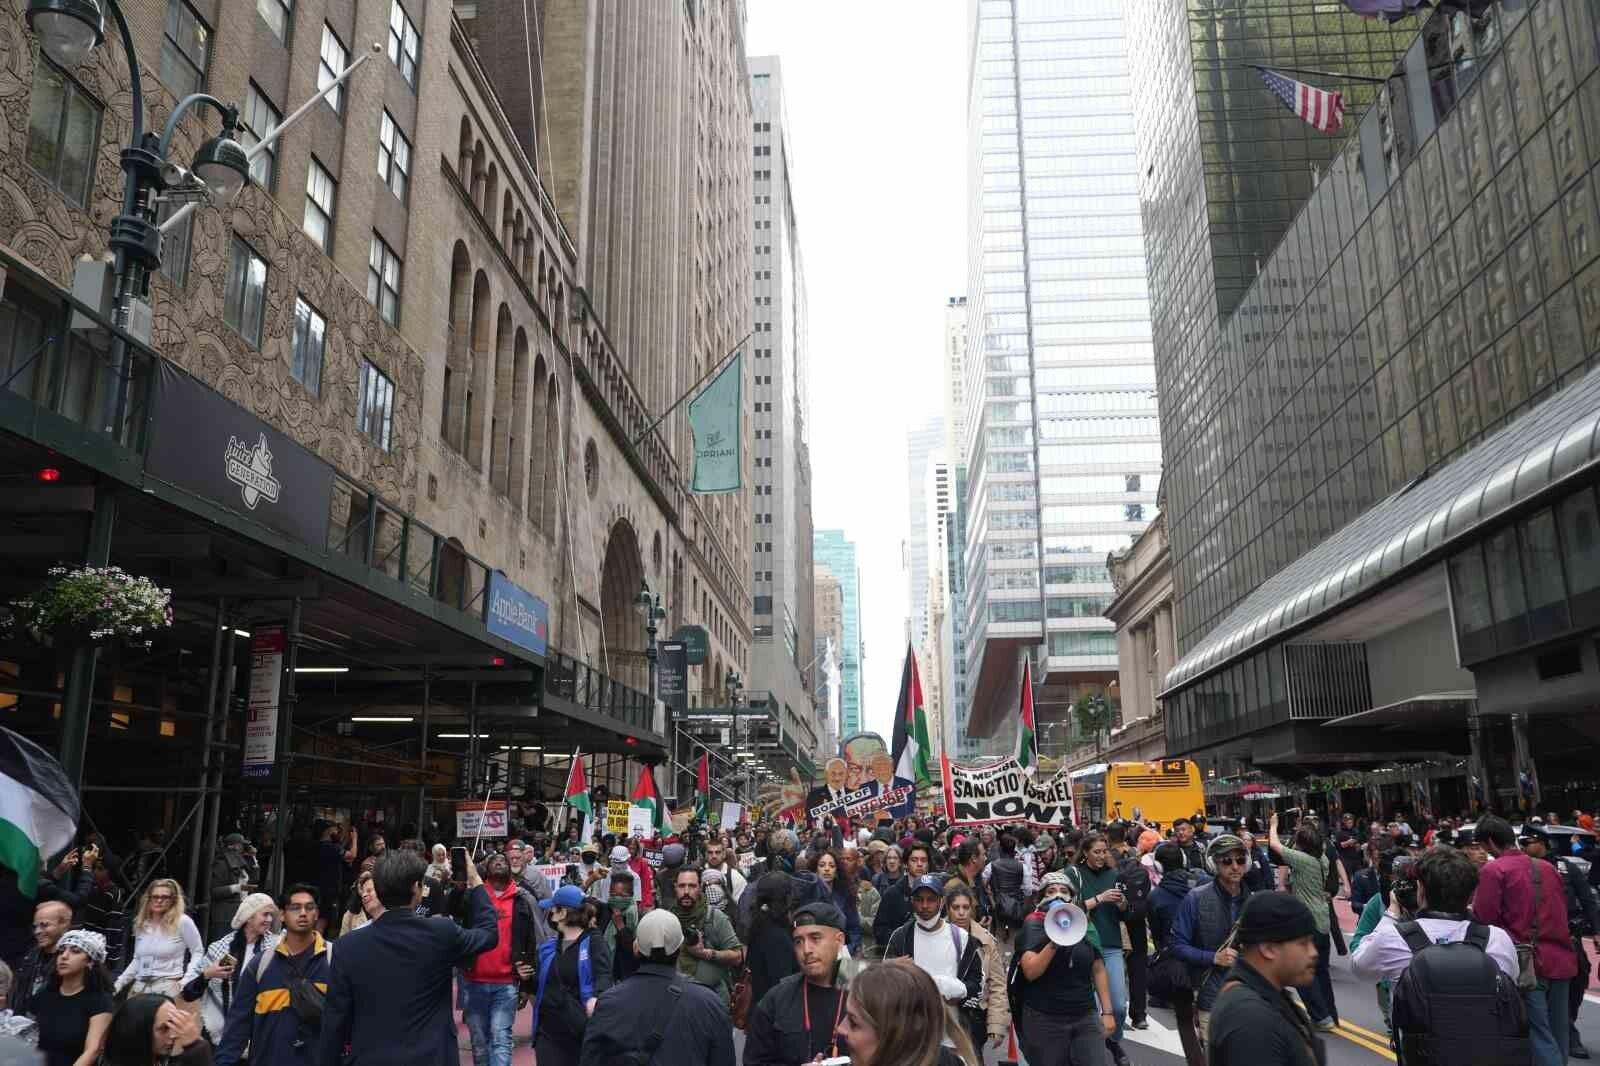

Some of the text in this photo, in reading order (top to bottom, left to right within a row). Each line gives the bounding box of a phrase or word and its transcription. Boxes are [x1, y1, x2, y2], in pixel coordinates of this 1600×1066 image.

[230, 461, 277, 498] GENERATION
[492, 588, 538, 635] Apple Bank
[811, 795, 853, 817] BOARD
[854, 787, 871, 800] OF
[953, 772, 1026, 799] SANCTIO
[1023, 778, 1072, 804] ISRAEL
[953, 797, 1073, 828] NOW!
